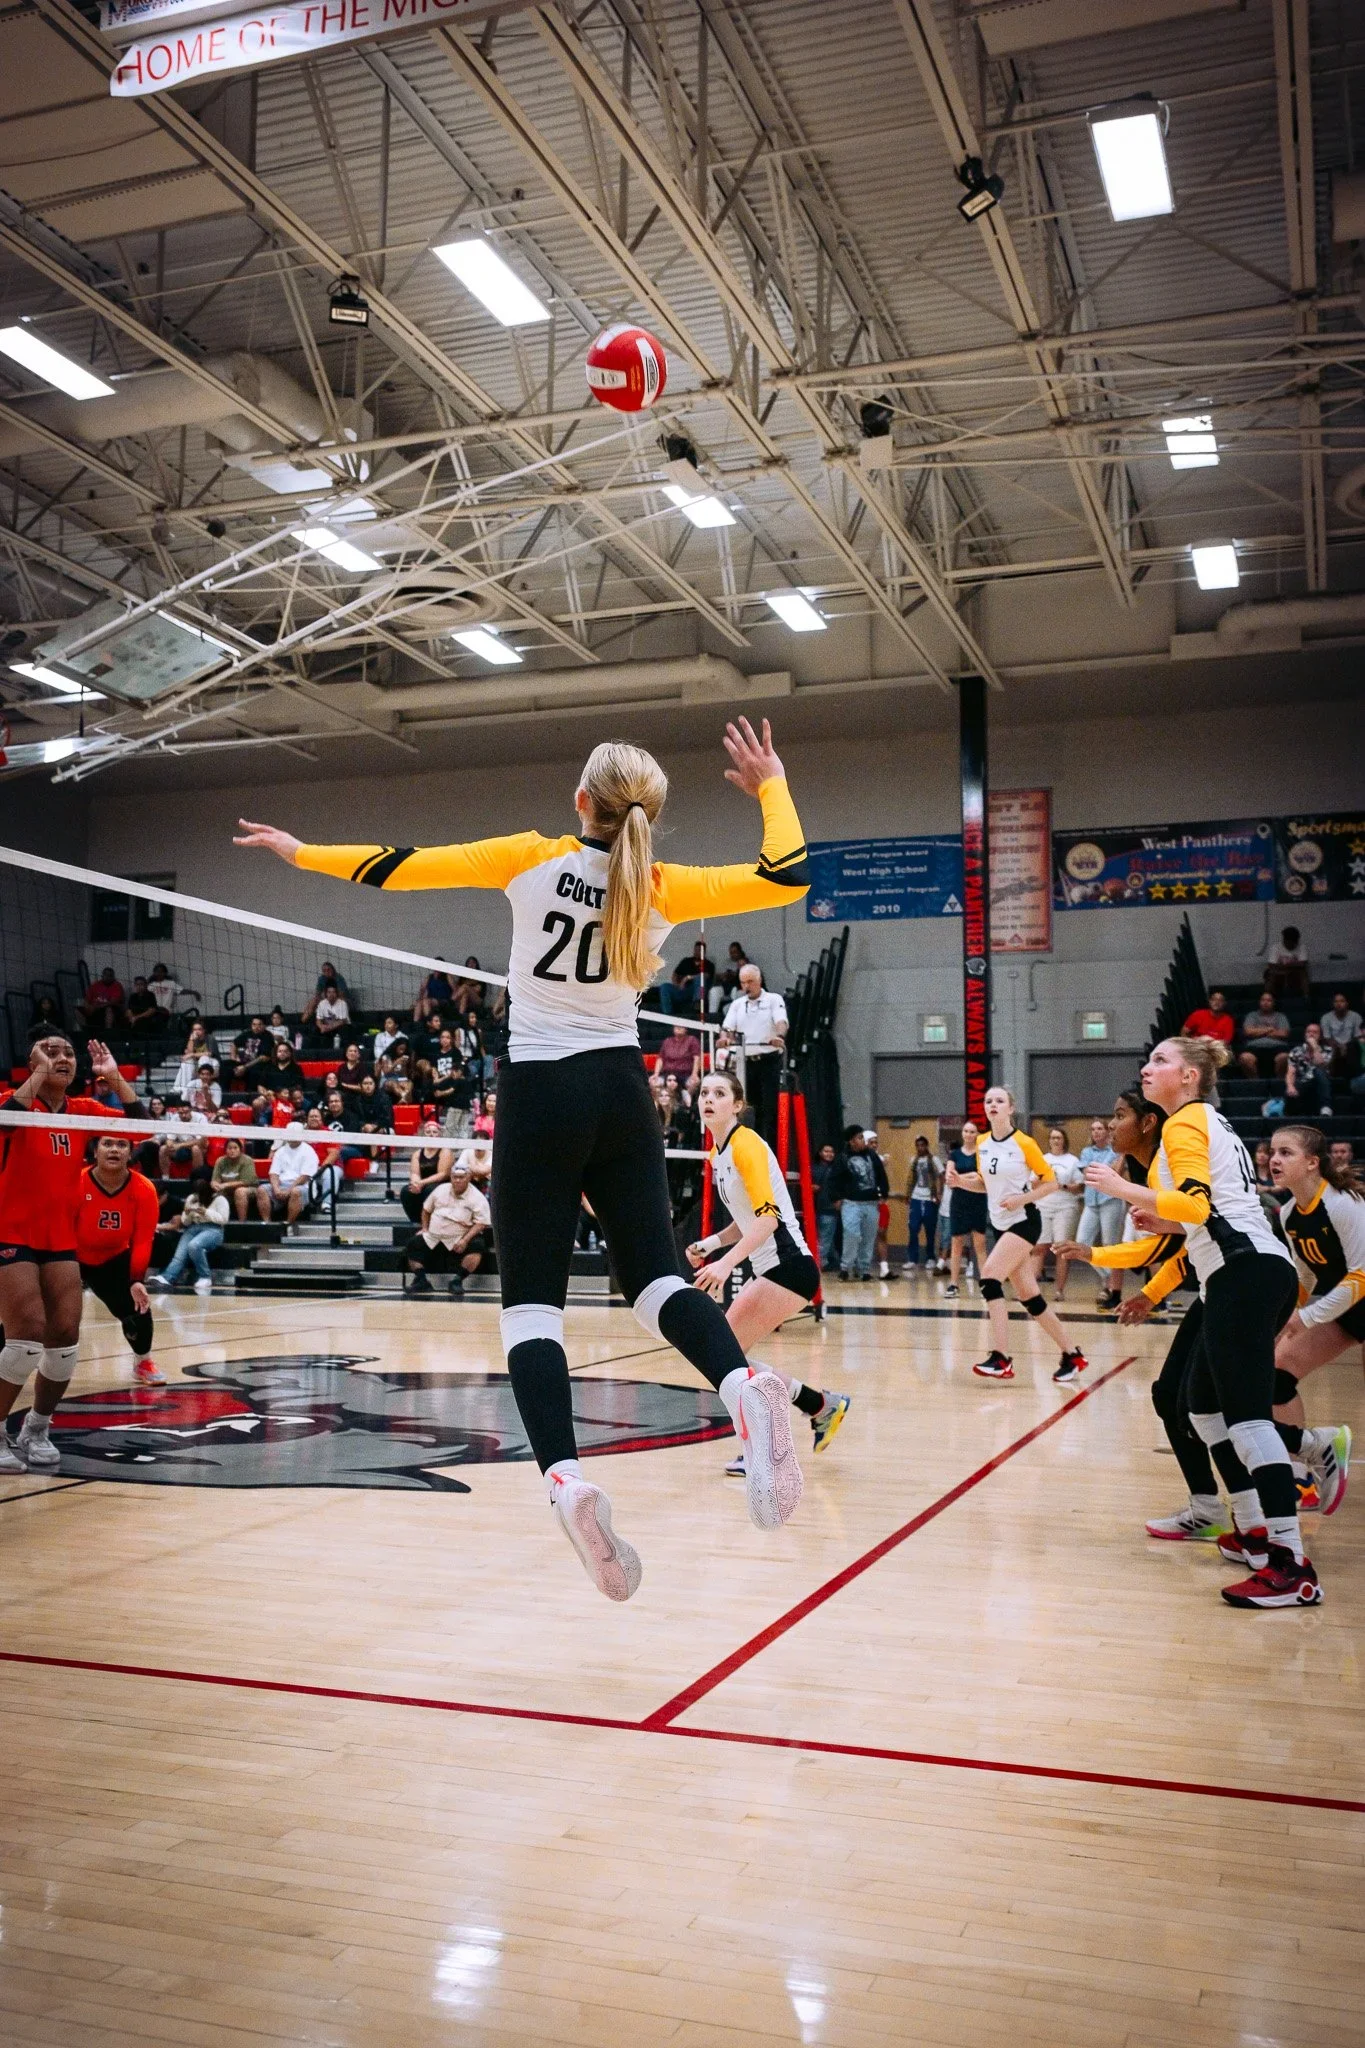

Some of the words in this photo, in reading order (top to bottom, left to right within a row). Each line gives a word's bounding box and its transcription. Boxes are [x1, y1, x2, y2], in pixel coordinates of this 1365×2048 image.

[117, 27, 226, 85] HOME
[302, 0, 370, 34] THE
[1141, 837, 1177, 850] West
[1181, 834, 1251, 848] Panthers
[842, 868, 867, 877] West
[869, 867, 892, 876] High
[894, 865, 928, 874] School
[872, 904, 901, 914] 2010
[964, 876, 986, 956] PANTHER
[532, 910, 610, 984] 20
[966, 978, 986, 1054] ALWAYS
[967, 1061, 986, 1074] A
[49, 1131, 71, 1157] 14
[988, 1157, 999, 1175] 3
[98, 1209, 122, 1230] 29
[1298, 1237, 1329, 1265] 10
